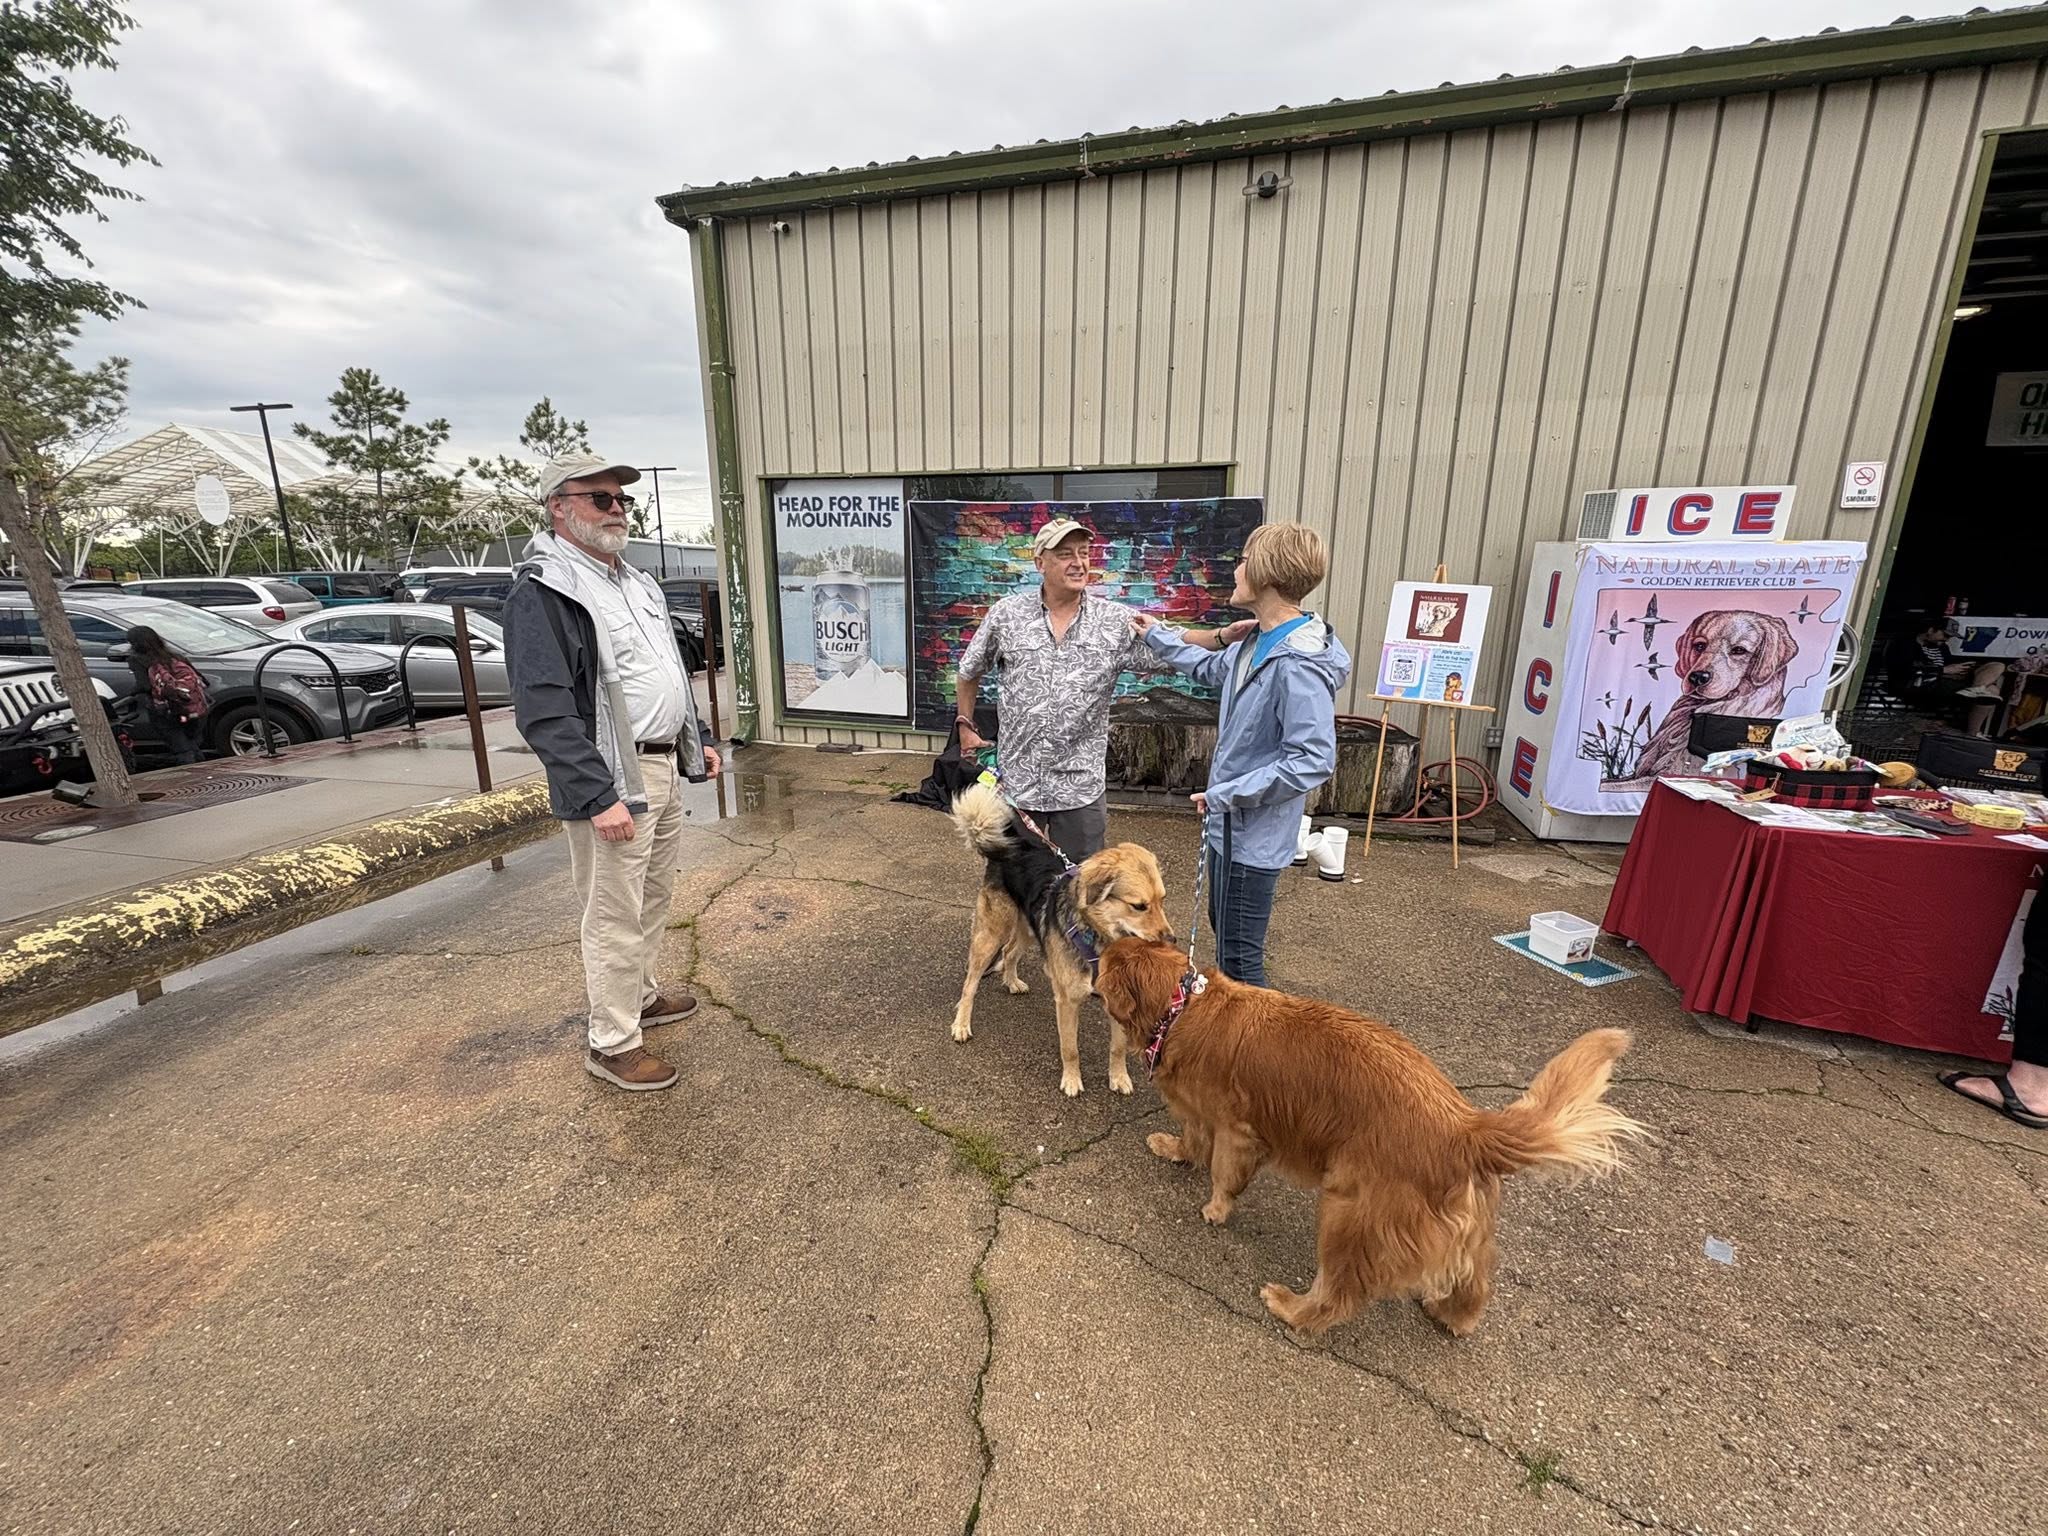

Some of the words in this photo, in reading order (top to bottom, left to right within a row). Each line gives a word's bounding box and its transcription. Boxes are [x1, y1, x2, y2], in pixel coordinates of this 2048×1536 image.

[778, 496, 823, 512] HEAD
[828, 496, 863, 512] FOR
[867, 496, 900, 512] THE
[786, 512, 893, 528] MOUNTAINS
[1625, 492, 1782, 536] ICE
[1595, 555, 1744, 575] NATURAL
[1752, 555, 1851, 575] STATE
[1640, 576, 1692, 586] GOLDEN
[1694, 577, 1760, 587] RETRIEVER
[1763, 577, 1796, 586] CLUB
[816, 621, 867, 641] BUSCH
[825, 641, 859, 652] LIGHT
[1510, 571, 1562, 798] ICE
